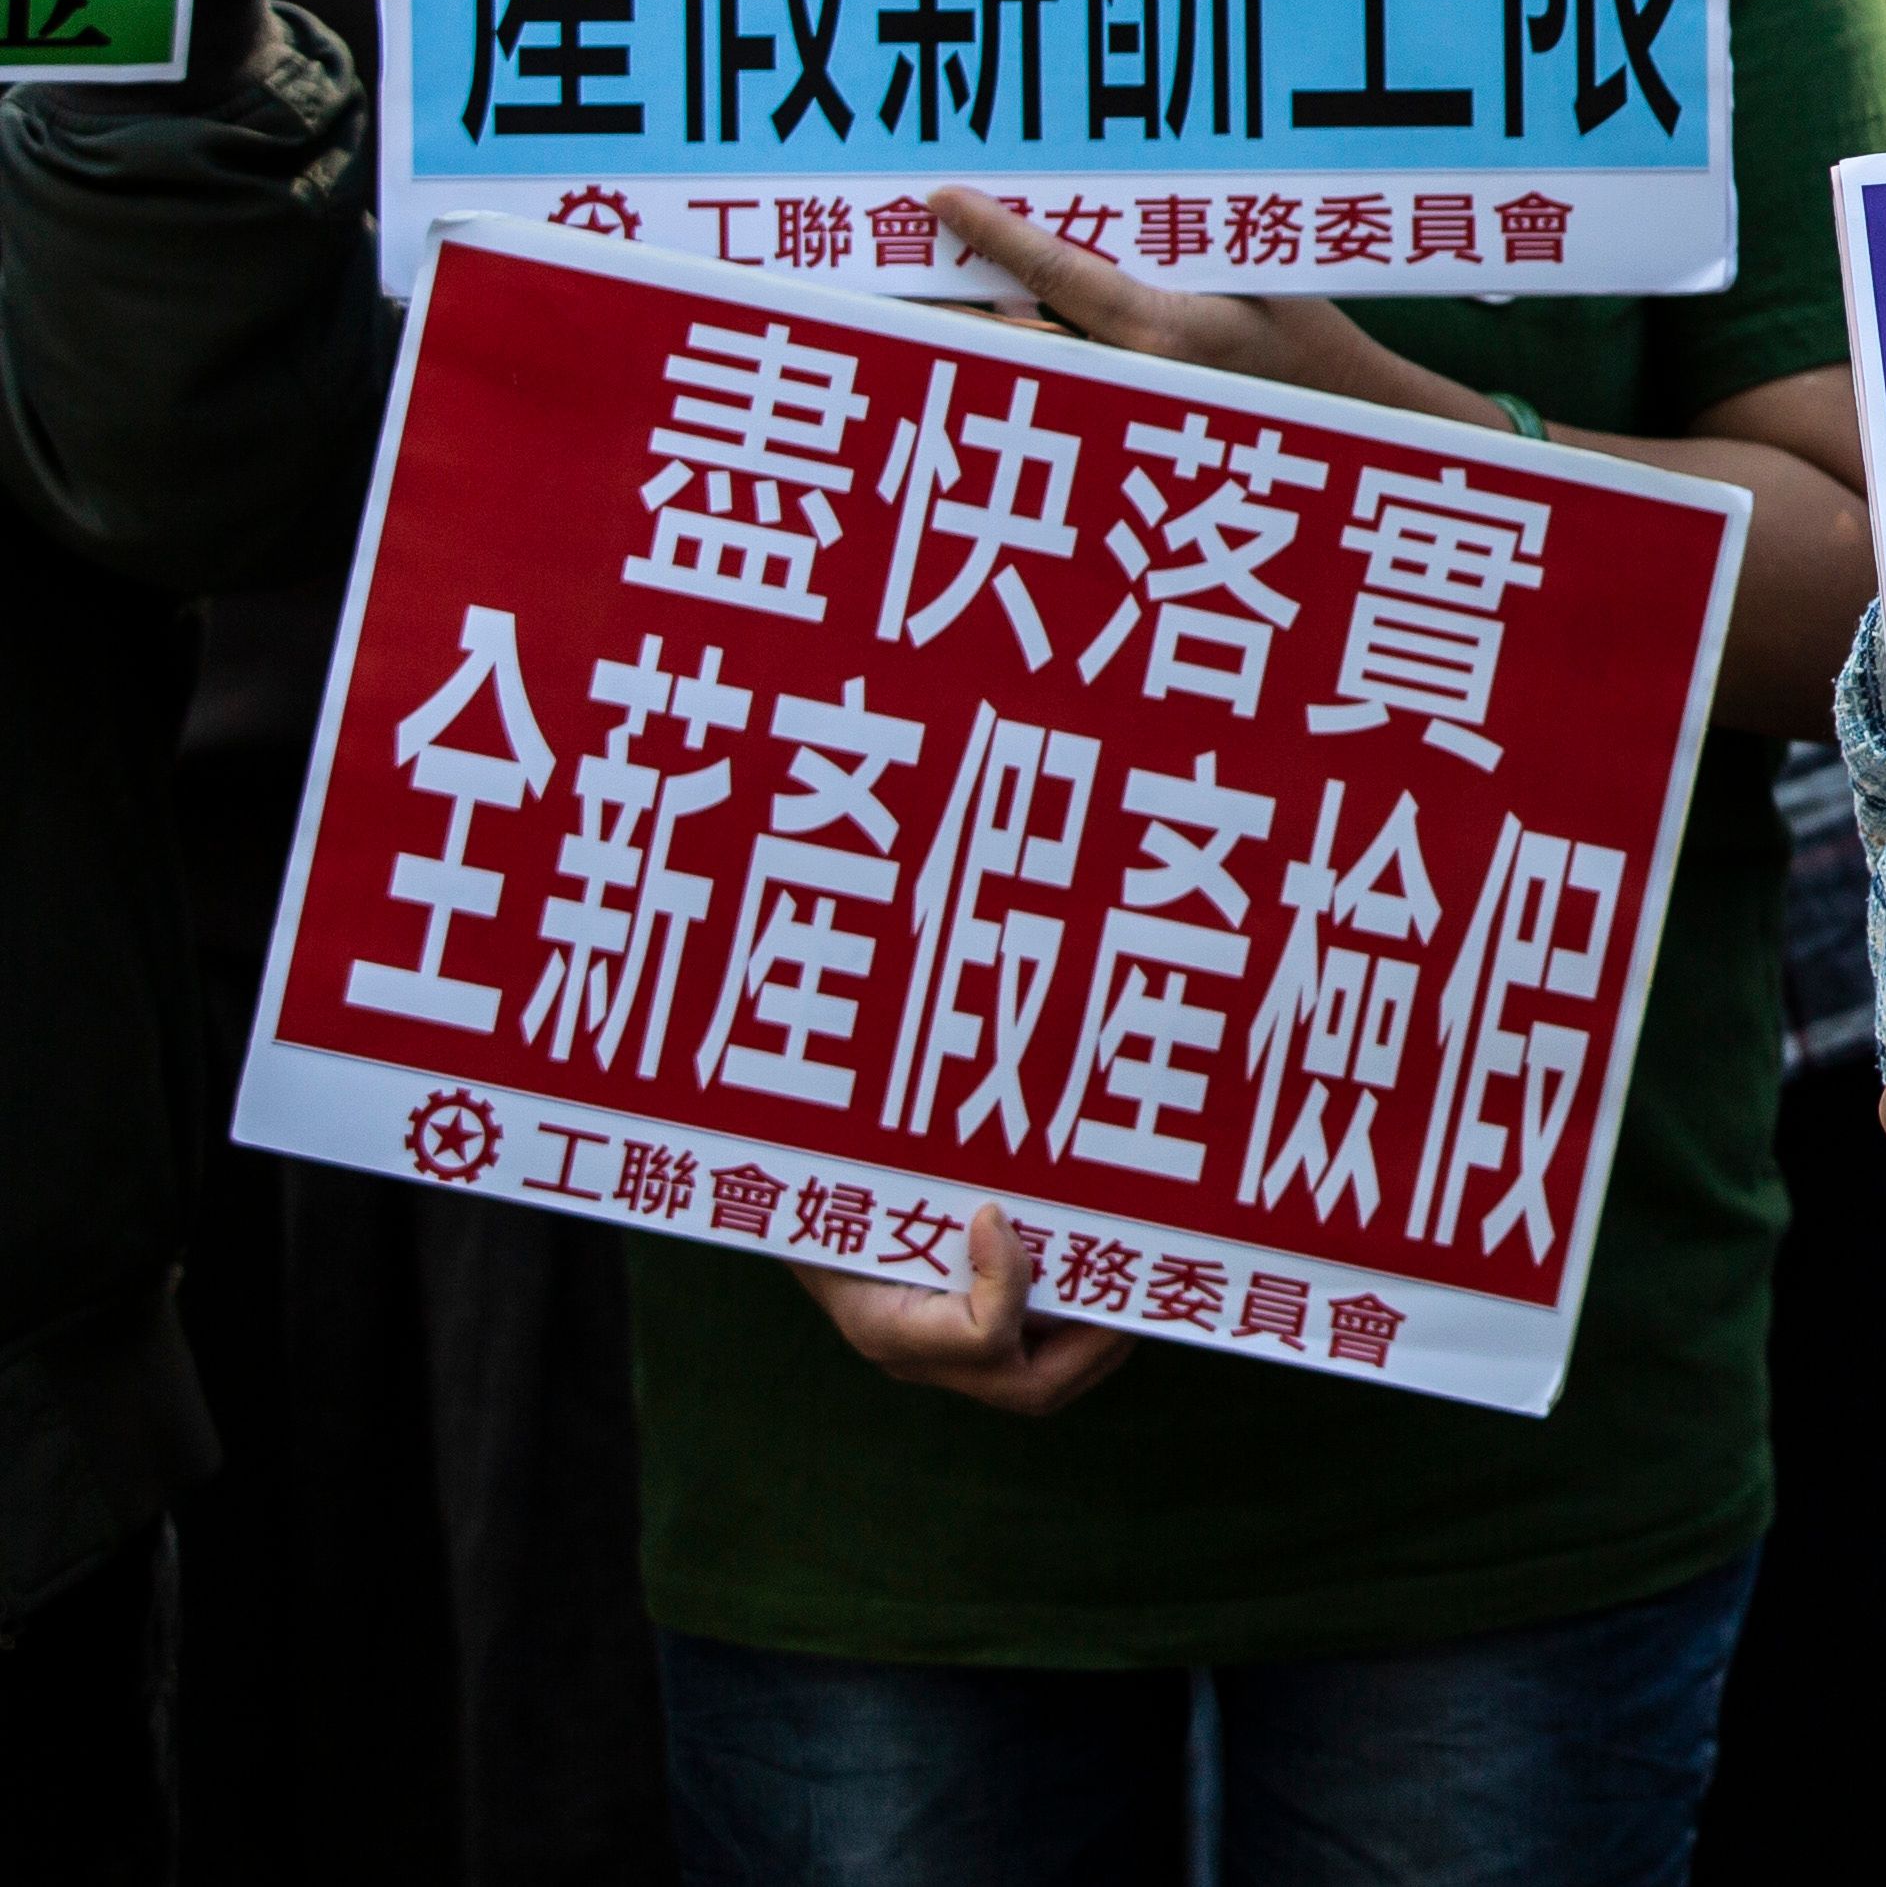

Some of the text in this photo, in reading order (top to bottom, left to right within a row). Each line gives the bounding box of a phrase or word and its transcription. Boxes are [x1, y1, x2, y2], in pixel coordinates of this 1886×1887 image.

[622, 321, 1552, 774] 盡快落實
[345, 604, 1626, 1265] 全薪產假產檢假
